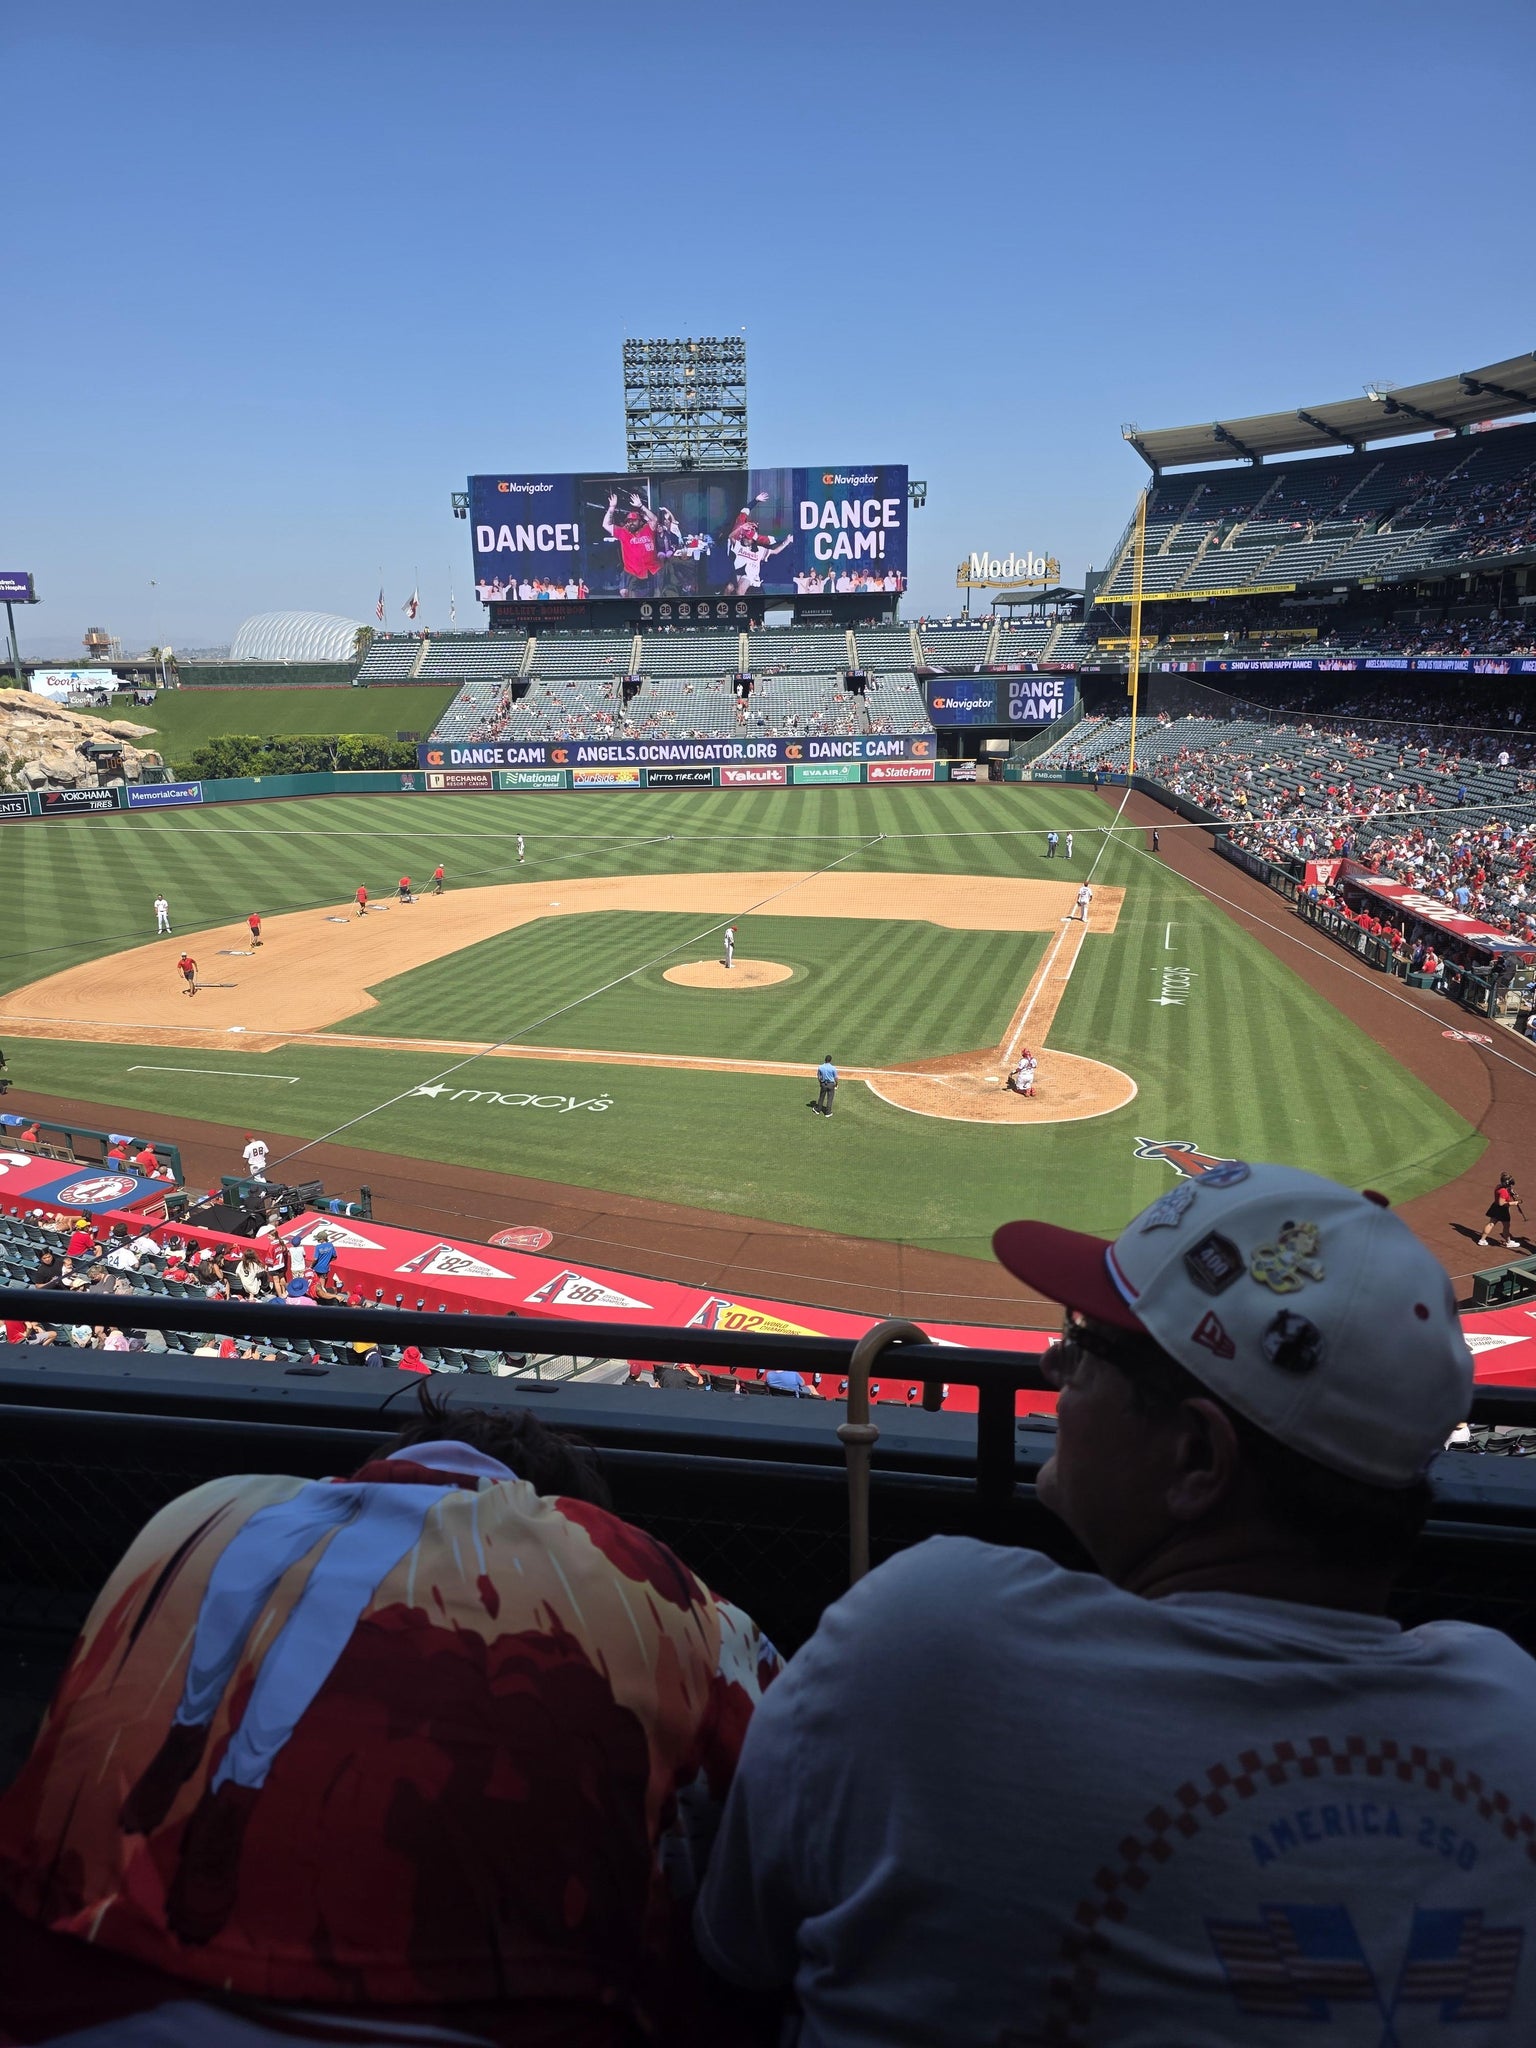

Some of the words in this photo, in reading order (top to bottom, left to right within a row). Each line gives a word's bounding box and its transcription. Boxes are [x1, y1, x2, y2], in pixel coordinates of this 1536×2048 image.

[832, 474, 879, 487] Navigator
[509, 482, 553, 495] Navigator
[801, 499, 900, 530] DANCE
[476, 524, 580, 553] DANCE!
[814, 531, 885, 560] CAM!
[970, 551, 1046, 579] Modelo
[643, 606, 650, 614] 11
[737, 604, 746, 612] 50
[1231, 662, 1250, 670] SHOW
[1274, 661, 1291, 669] HAPPY
[1292, 661, 1312, 669] DANCE!
[1008, 681, 1064, 698] DANCE
[946, 697, 993, 711] Navigator
[1008, 699, 1064, 720] CAM!
[450, 748, 504, 764] DANCE
[507, 747, 546, 764] CAM!
[576, 744, 777, 762] ANGELS.OCNAVIGATOR.ORG
[809, 741, 862, 758] DANCE
[866, 740, 904, 757] CAM!
[518, 772, 560, 783] National
[577, 773, 614, 785] Surfside
[650, 772, 673, 781] NITTO
[675, 771, 711, 781] TIRE.COM
[725, 769, 783, 781] Yakult
[1035, 772, 1062, 780] FMB.com
[61, 790, 112, 801] YOKOHAMA
[132, 789, 188, 801] MemorialCare
[90, 801, 112, 809] TIRES
[109, 1255, 120, 1267] 24
[437, 1256, 474, 1273] '82
[566, 1284, 604, 1303] '86
[725, 1312, 764, 1332] '02
[764, 1320, 789, 1329] WORLD
[1249, 1802, 1402, 1868] AMERICA
[1417, 1816, 1479, 1871] 250
